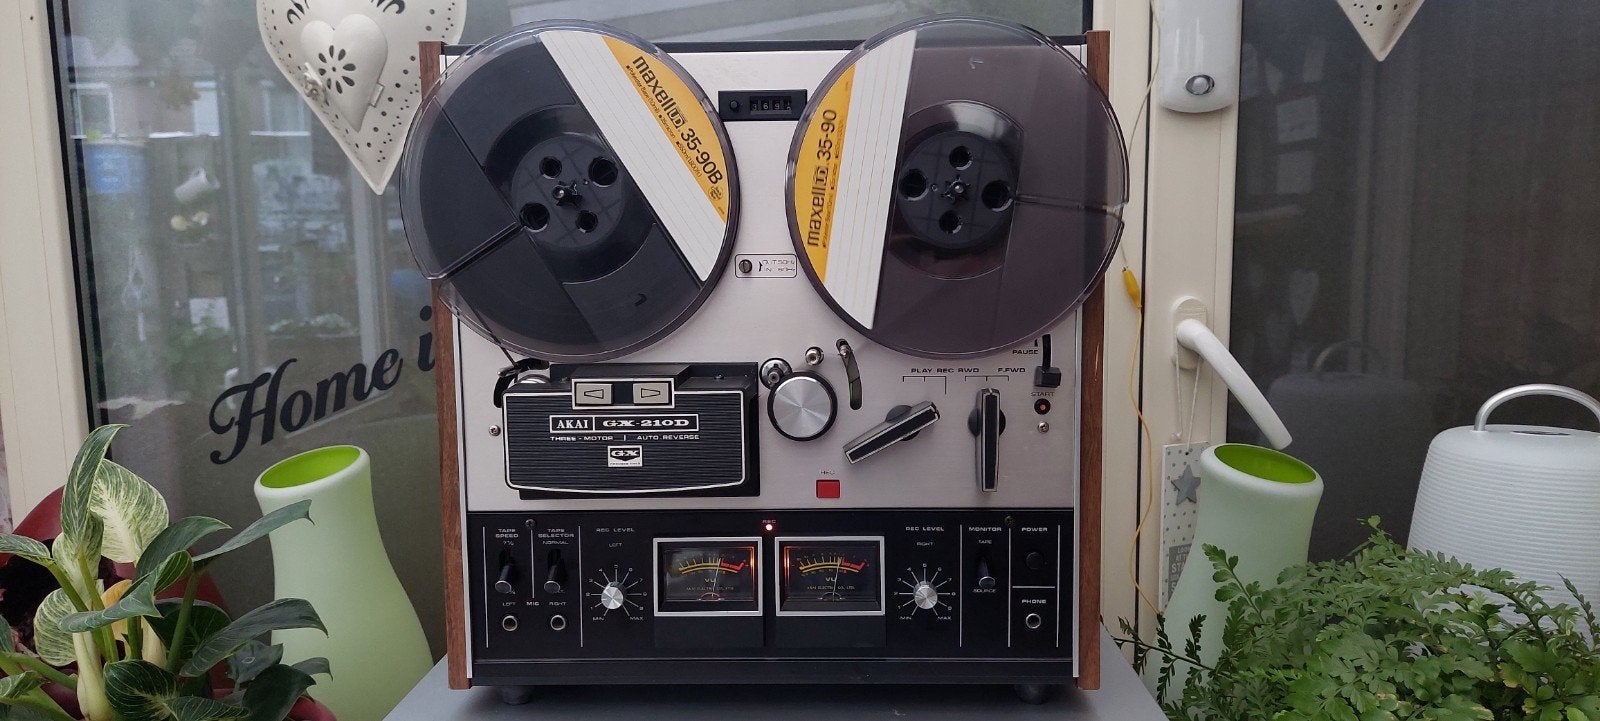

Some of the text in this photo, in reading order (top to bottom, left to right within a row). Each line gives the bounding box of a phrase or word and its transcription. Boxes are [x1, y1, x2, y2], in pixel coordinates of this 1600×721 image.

[633, 56, 673, 112] maxell
[681, 128, 723, 184] 35-90B
[808, 186, 826, 247] maxell
[817, 109, 837, 160] 35-90
[209, 306, 435, 464] Home i
[557, 420, 588, 429] AKAI
